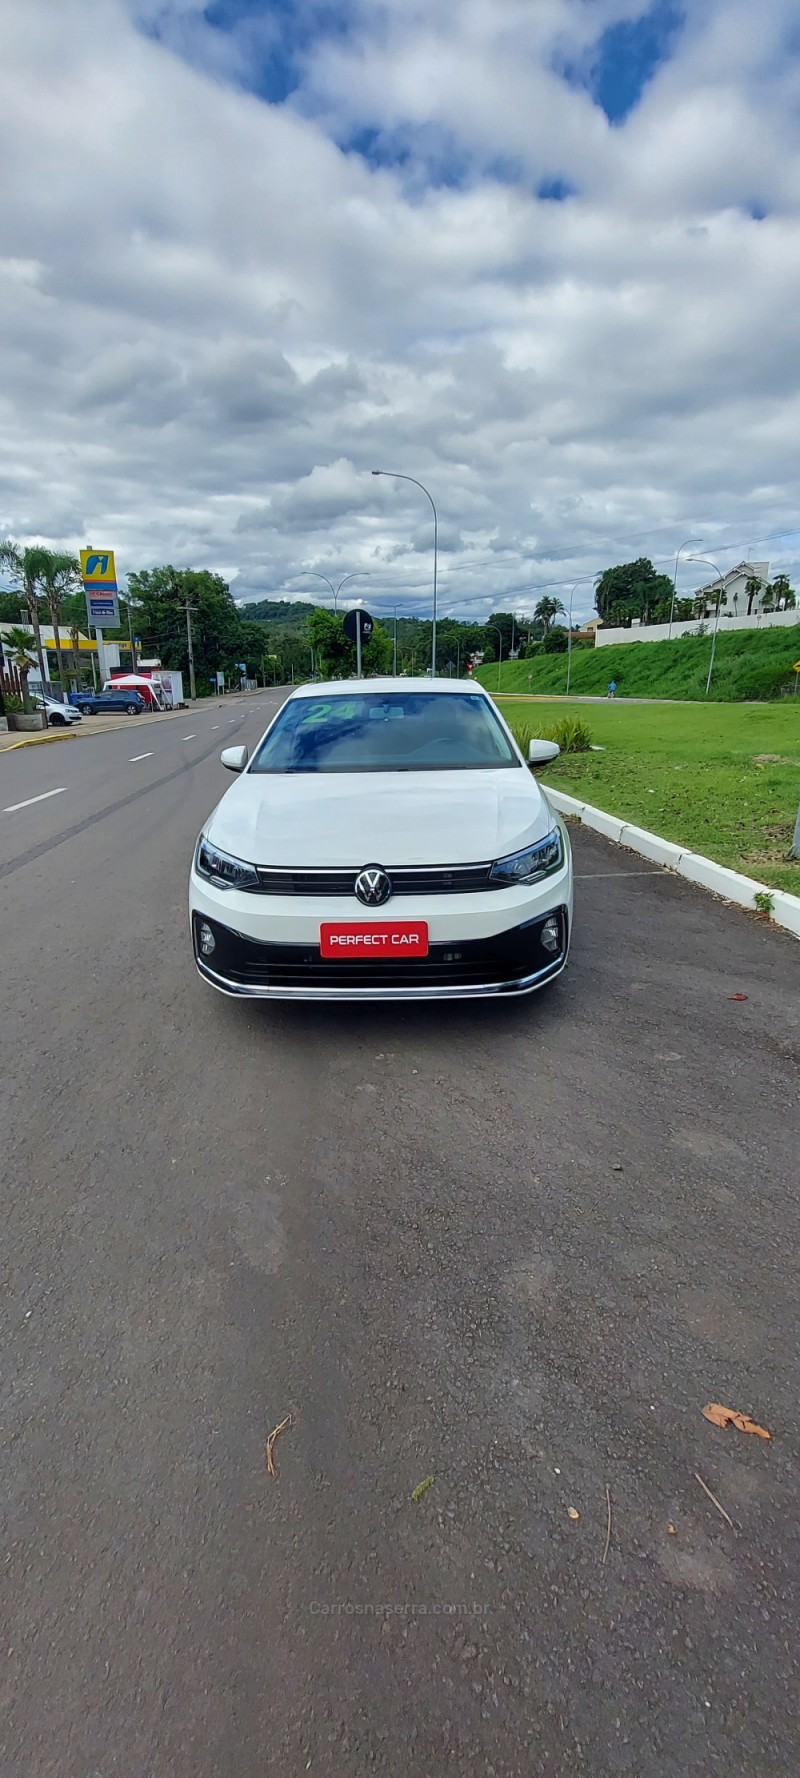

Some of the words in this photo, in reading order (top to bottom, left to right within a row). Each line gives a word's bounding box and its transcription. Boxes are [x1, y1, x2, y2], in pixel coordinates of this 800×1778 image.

[302, 701, 356, 723] 24
[329, 934, 388, 945] PERFECT
[391, 934, 419, 944] CAR
